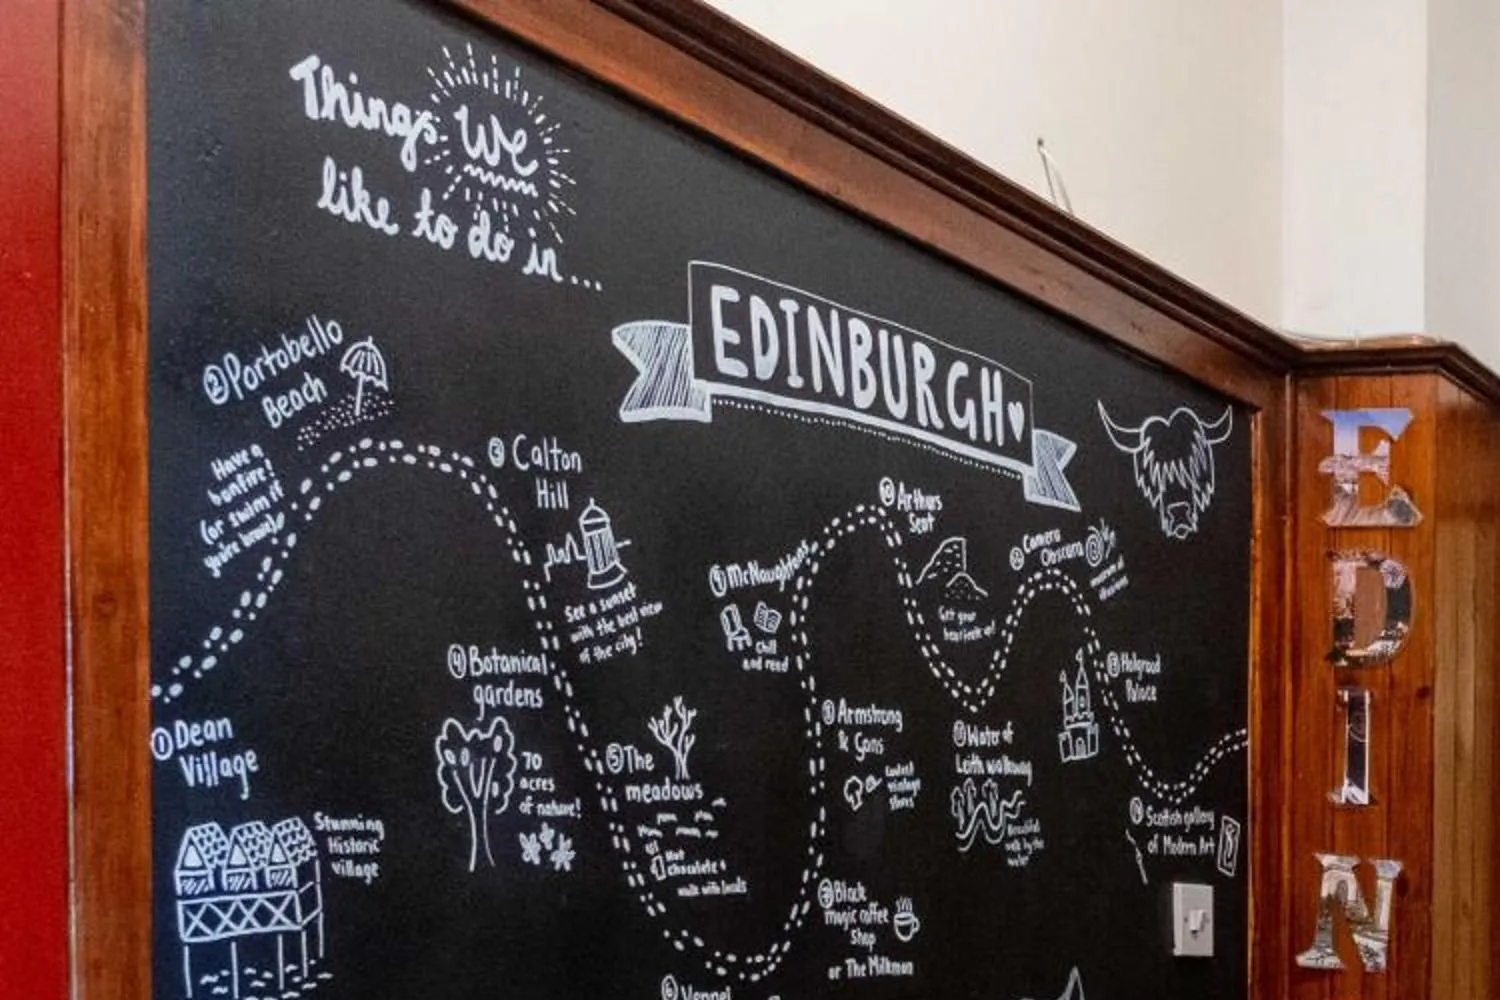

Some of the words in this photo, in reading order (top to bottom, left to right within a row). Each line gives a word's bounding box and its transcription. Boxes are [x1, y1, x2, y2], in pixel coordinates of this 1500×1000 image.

[290, 55, 440, 170] Things
[454, 104, 539, 176] We
[317, 157, 399, 236] like
[412, 189, 459, 251] to
[468, 211, 515, 263] do
[226, 315, 344, 400] Portobello
[710, 284, 1004, 447] EDINBURGH
[262, 372, 329, 428] Beach
[211, 449, 251, 481] Have
[250, 443, 265, 459] a
[512, 434, 583, 473] Calton
[535, 477, 569, 510] Hill
[897, 481, 943, 512] Arthurs
[228, 495, 271, 528] swim
[909, 513, 935, 534] Seat
[1023, 529, 1061, 553] Camera
[1040, 541, 1085, 567] Obscura
[564, 605, 586, 624] See
[596, 617, 617, 637] the
[469, 645, 549, 677] Botanical
[1121, 651, 1161, 682] Holyrood
[473, 679, 543, 721] gardens
[838, 697, 903, 733] Armstrong
[175, 717, 235, 750] Dean
[967, 723, 1000, 747] Water
[624, 744, 655, 774] The
[955, 752, 985, 775] Leith
[179, 750, 260, 800] Village
[519, 776, 555, 792] acres
[625, 776, 705, 804] meadows
[519, 795, 532, 815] of
[1145, 804, 1183, 827] Scottish
[313, 811, 386, 842] Stunning
[328, 836, 382, 856] Historic
[1147, 833, 1159, 855] of
[1163, 835, 1197, 857] Modern
[1199, 835, 1216, 857] Art
[833, 880, 867, 903] Black
[859, 900, 889, 925] coffee
[828, 965, 843, 981] or
[844, 957, 867, 979] The
